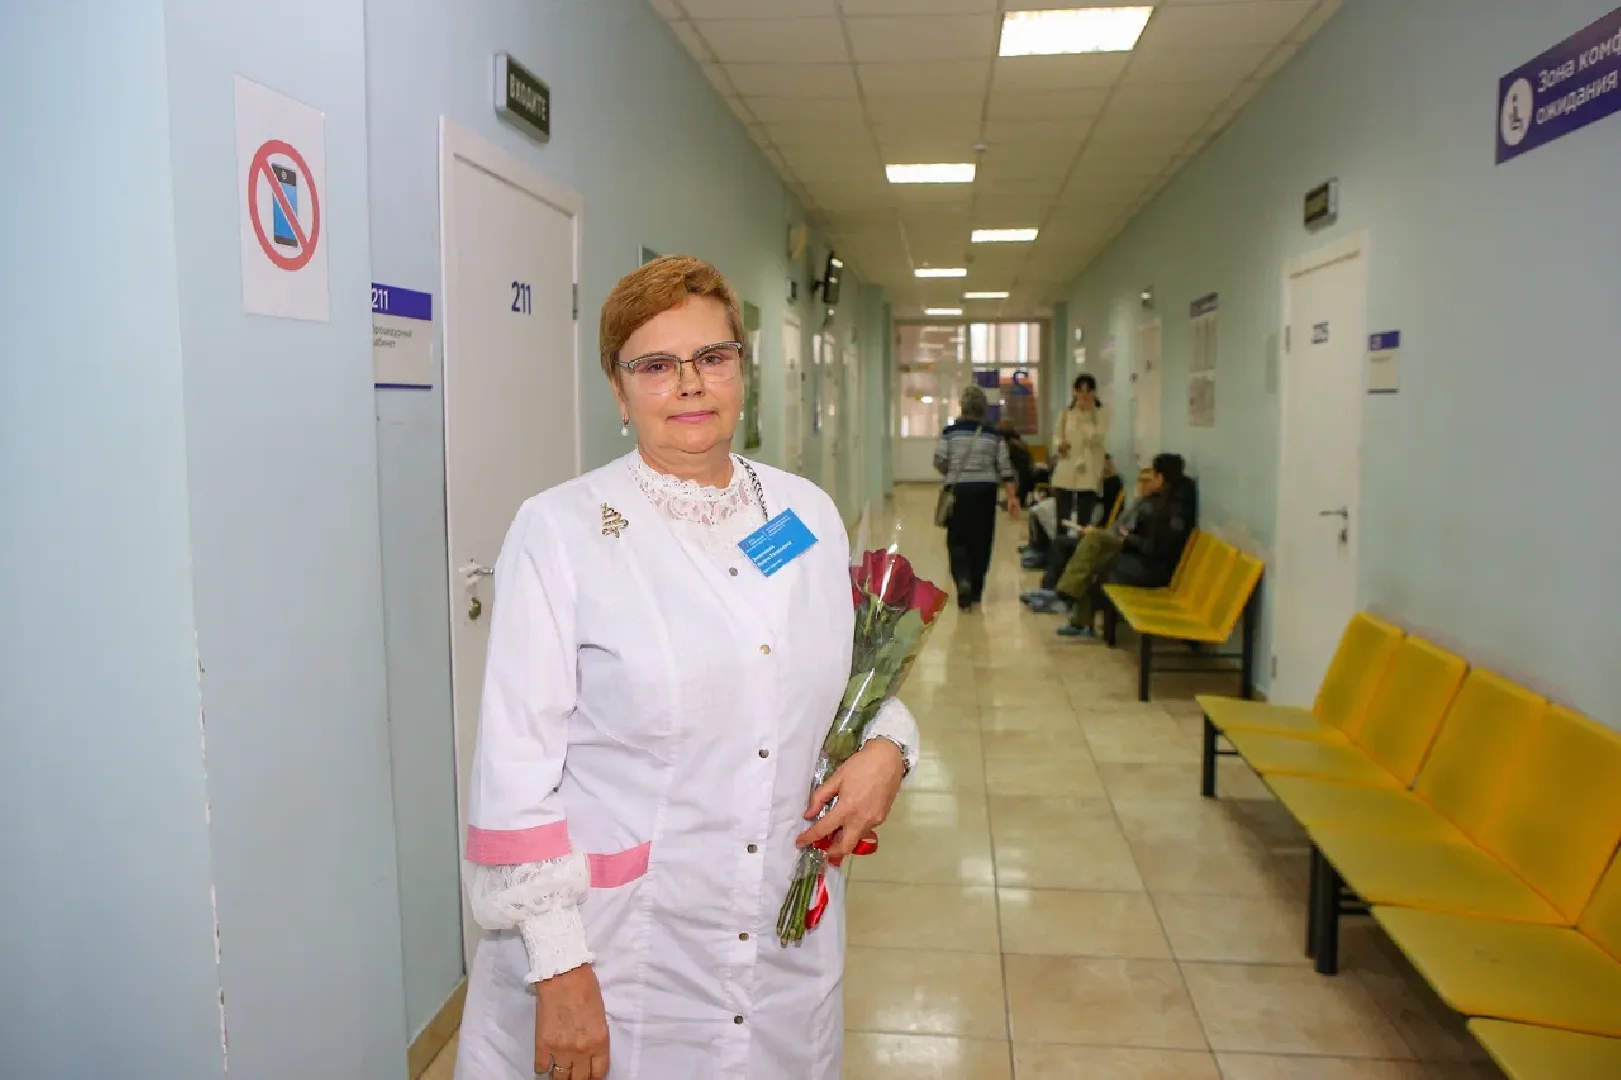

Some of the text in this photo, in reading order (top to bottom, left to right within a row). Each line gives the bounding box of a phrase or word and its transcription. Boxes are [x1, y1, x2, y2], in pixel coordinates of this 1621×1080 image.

[1537, 60, 1575, 92] Зона
[1536, 70, 1618, 125] ожидания
[371, 288, 388, 311] 211
[511, 280, 531, 315] 211
